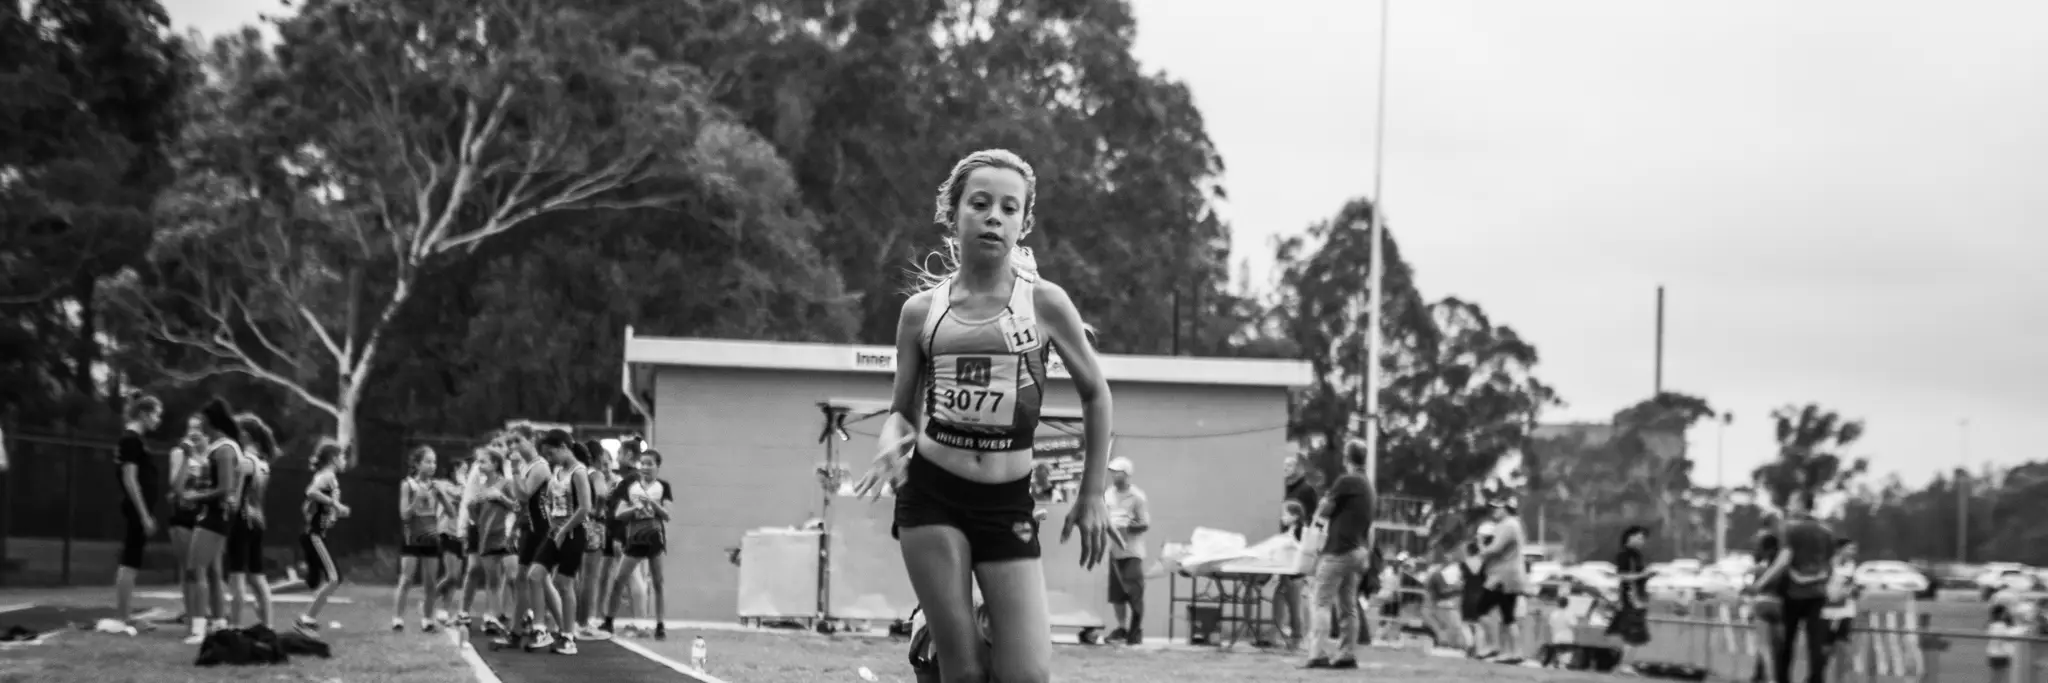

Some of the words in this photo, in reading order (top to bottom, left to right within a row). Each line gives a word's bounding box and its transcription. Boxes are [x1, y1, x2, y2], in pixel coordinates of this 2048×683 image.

[1012, 329, 1034, 346] 11
[856, 351, 892, 368] Inner
[944, 389, 1004, 413] 3077
[936, 431, 974, 448] INNER
[979, 438, 1013, 449] WEST
